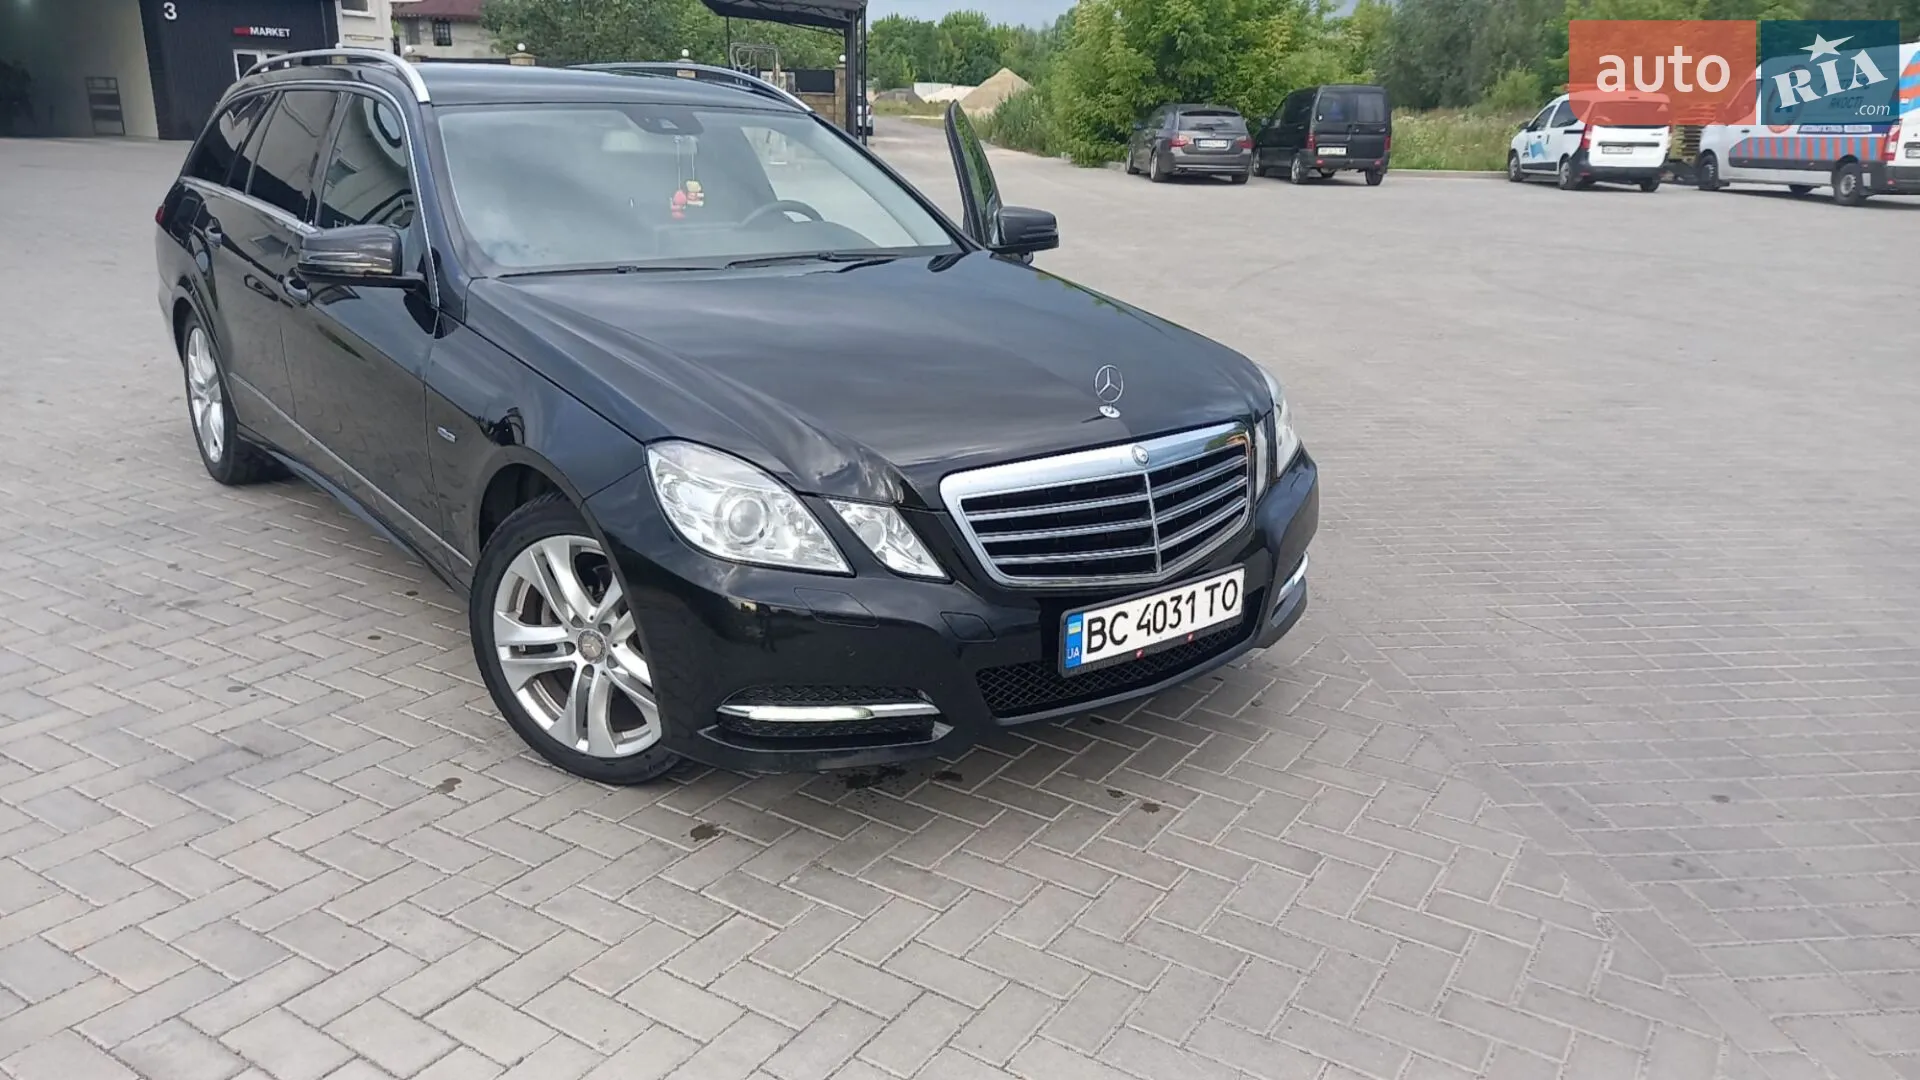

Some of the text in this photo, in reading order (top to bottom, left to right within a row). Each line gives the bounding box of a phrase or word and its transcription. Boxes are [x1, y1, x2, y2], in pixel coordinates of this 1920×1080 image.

[163, 2, 177, 20] 3
[249, 26, 290, 37] MARKET
[1086, 578, 1238, 654] BC 4031 TO
[1067, 647, 1080, 660] UA
